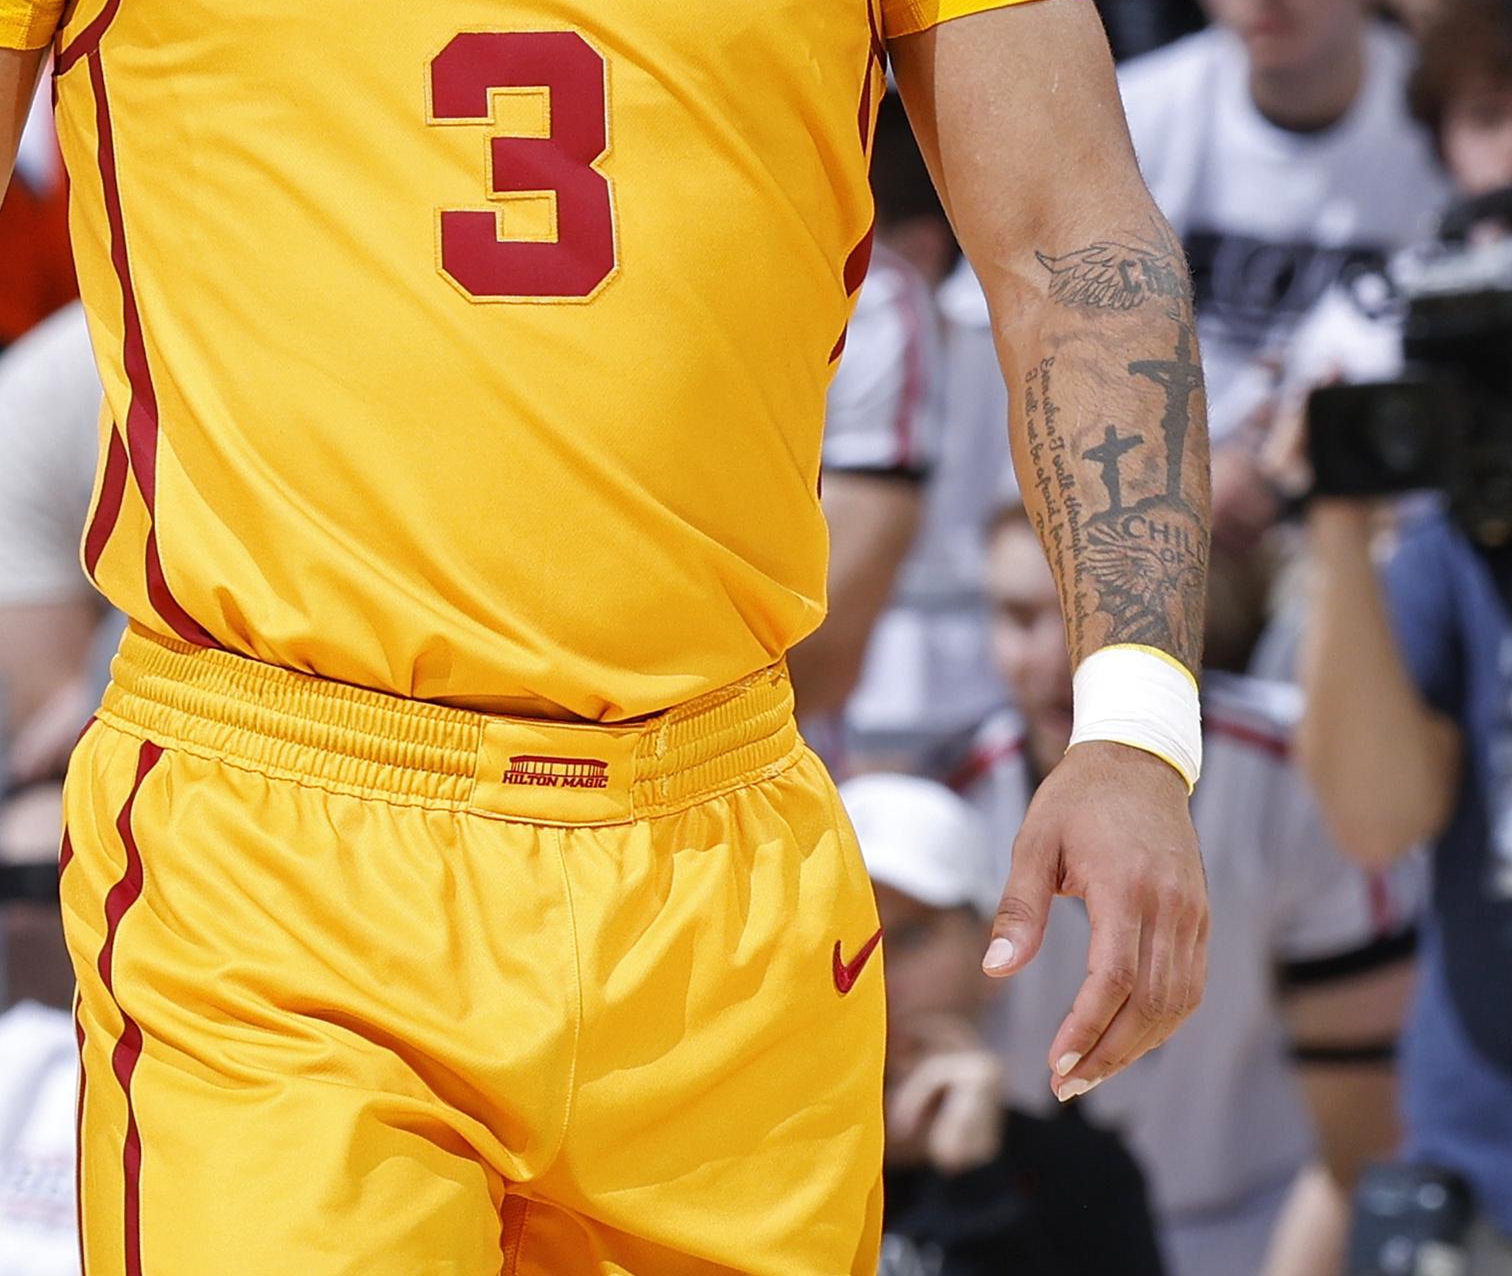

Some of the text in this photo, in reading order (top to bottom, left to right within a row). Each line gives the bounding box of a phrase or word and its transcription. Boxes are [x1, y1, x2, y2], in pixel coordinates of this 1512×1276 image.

[427, 28, 621, 302] 3
[502, 773, 608, 789] HILTON MAGIC
